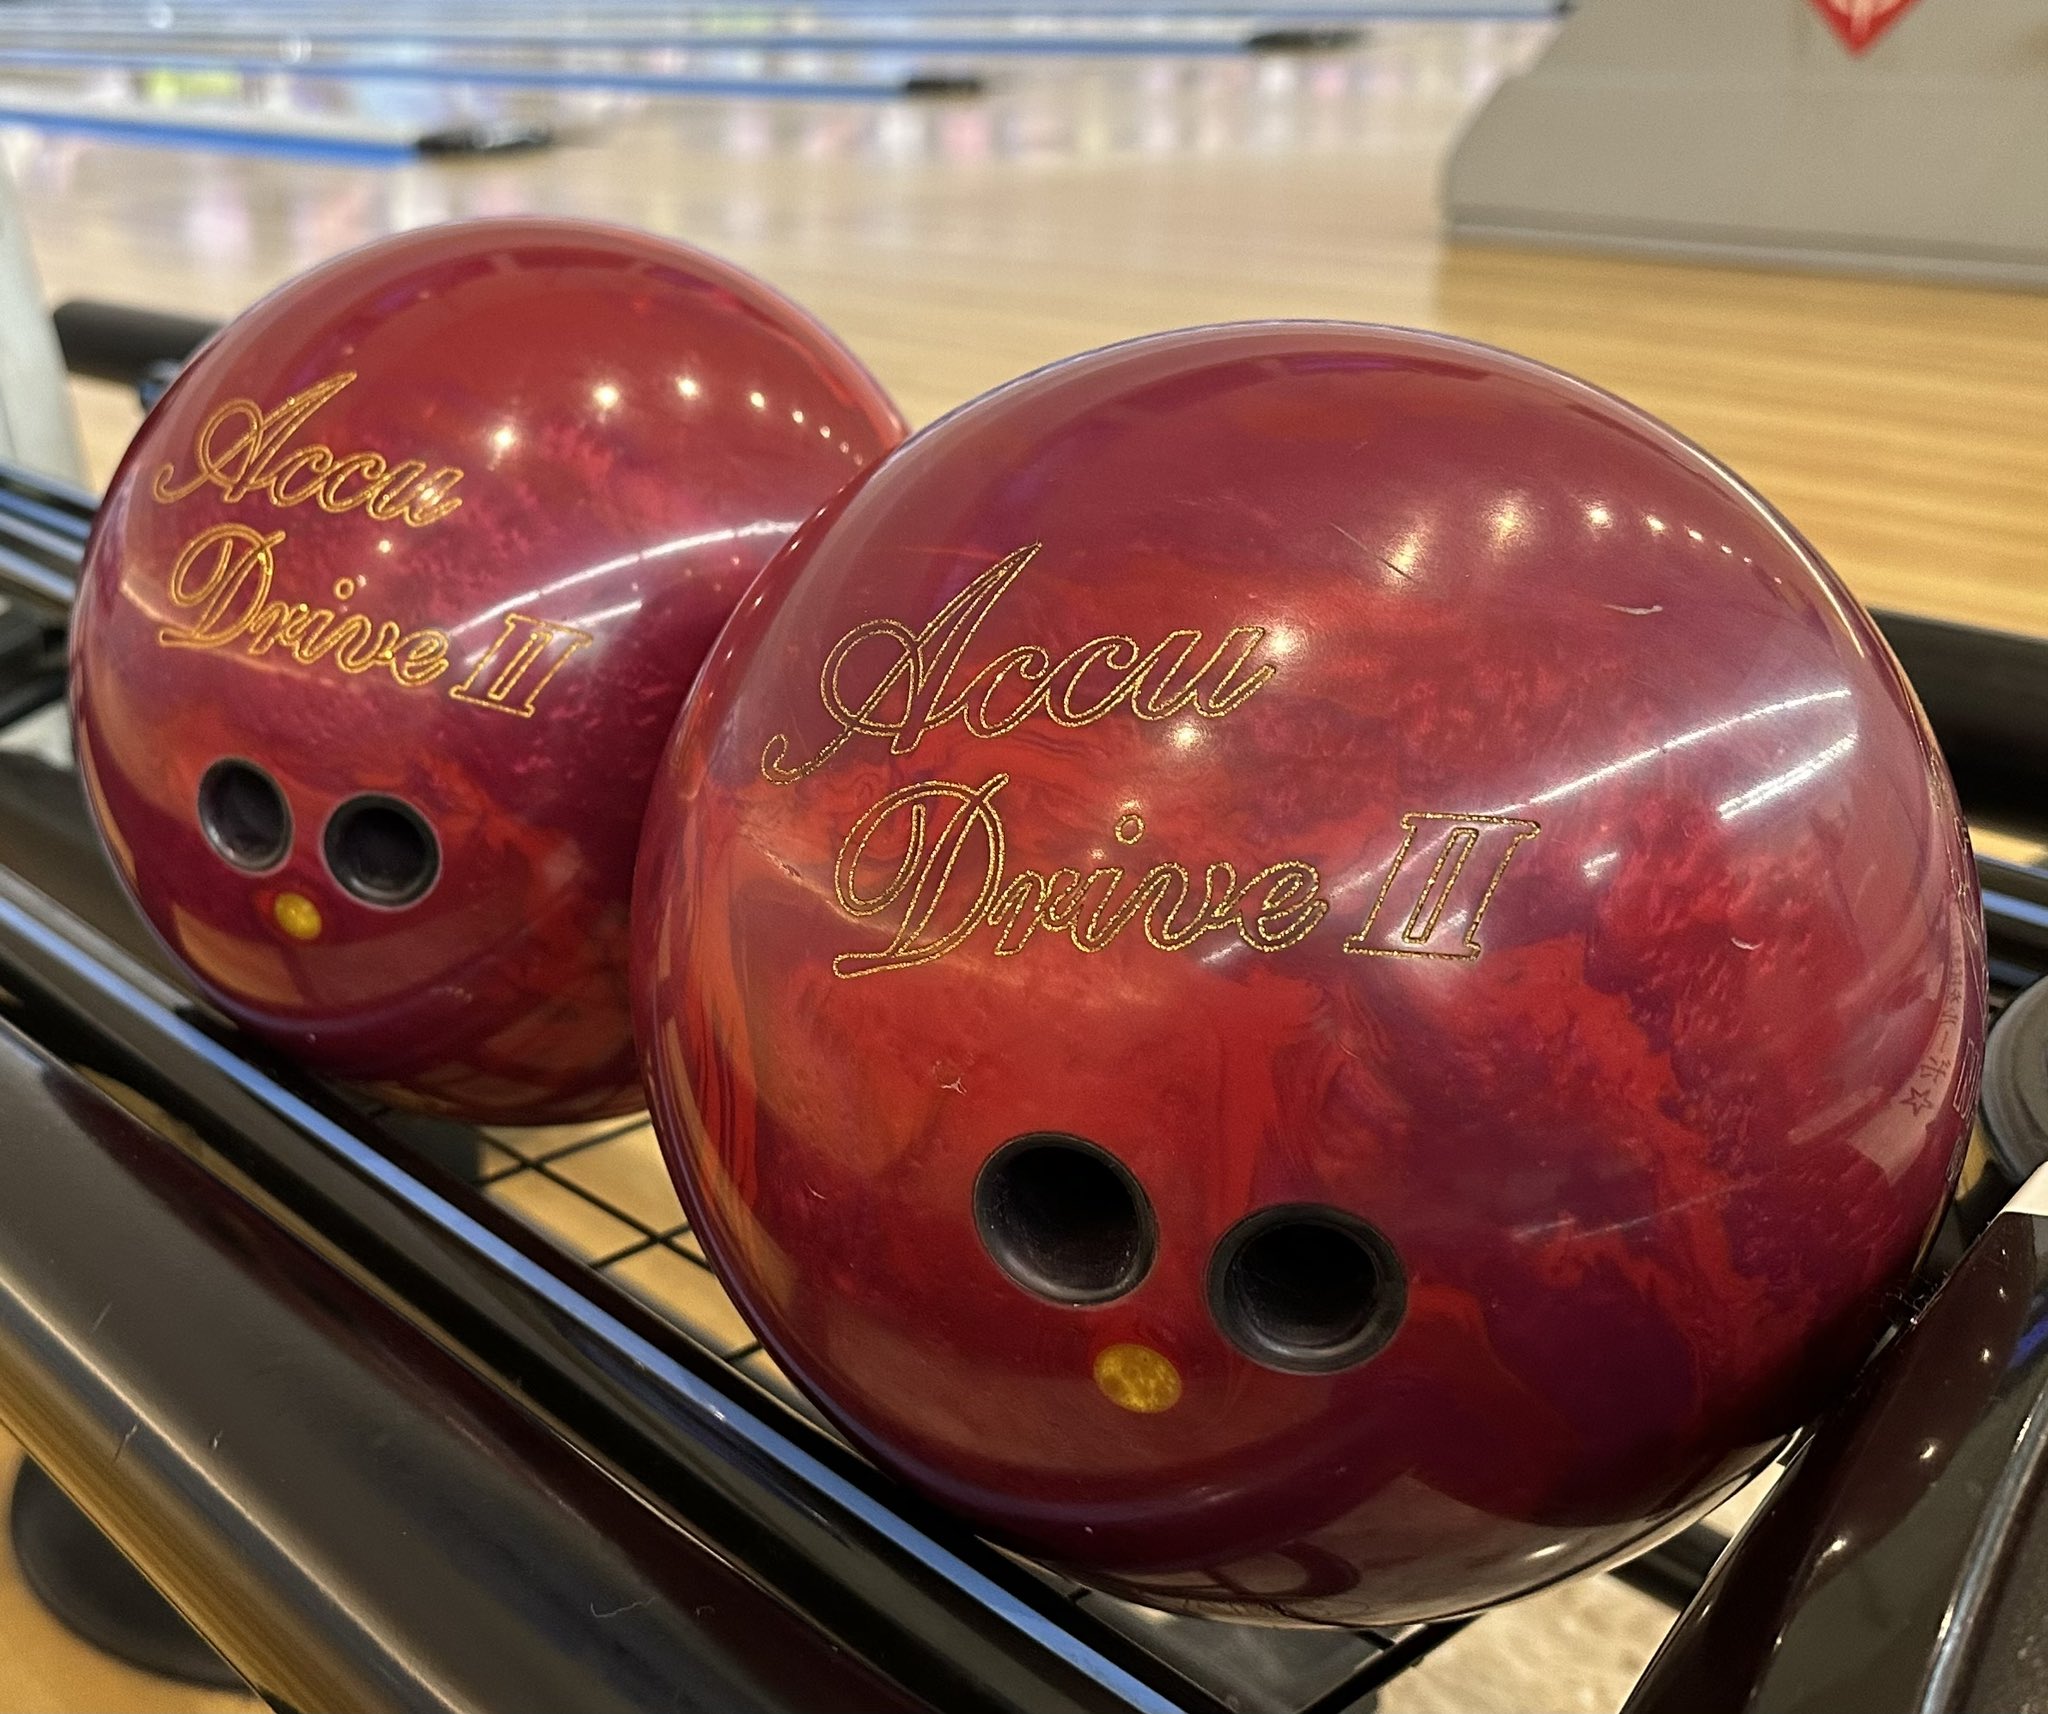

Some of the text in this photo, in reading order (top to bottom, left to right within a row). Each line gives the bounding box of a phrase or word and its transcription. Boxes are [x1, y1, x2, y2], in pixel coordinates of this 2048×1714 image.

[153, 370, 464, 527] Accu
[159, 523, 593, 718] Drive II
[761, 542, 1277, 786] Accu
[833, 772, 1542, 980] Drive II
